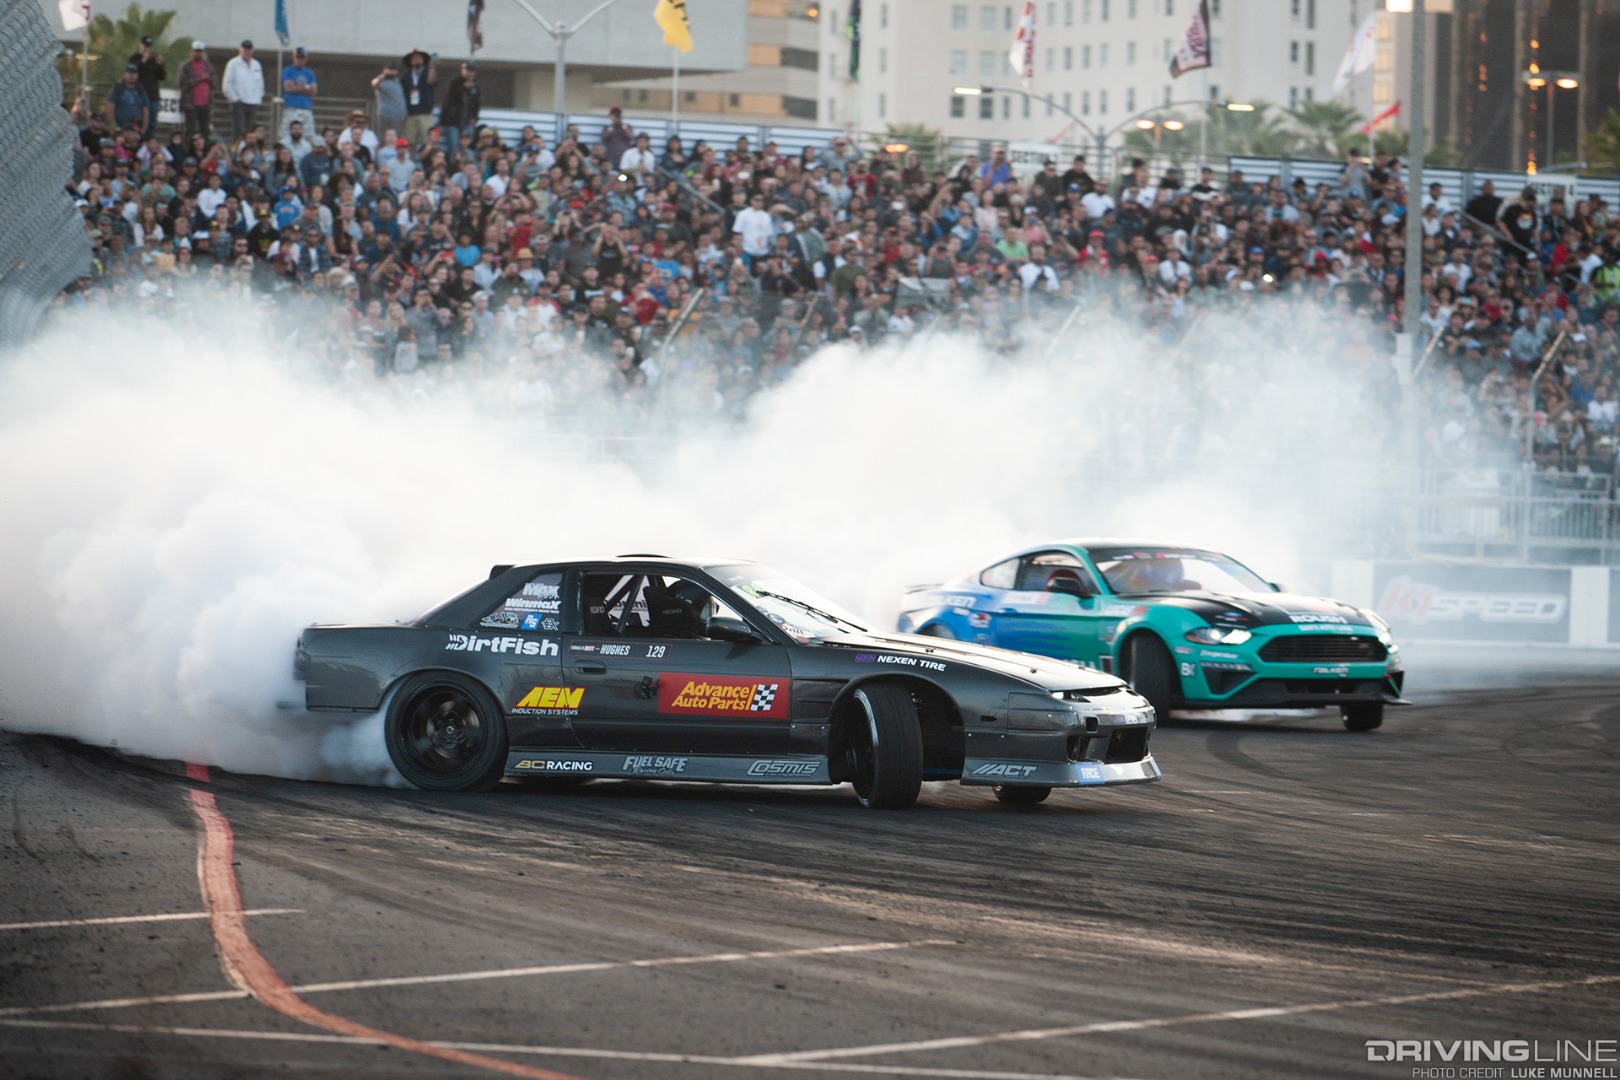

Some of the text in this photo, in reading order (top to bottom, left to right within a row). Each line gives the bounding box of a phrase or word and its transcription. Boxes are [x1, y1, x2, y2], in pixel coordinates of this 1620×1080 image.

[445, 634, 559, 656] DirtFish
[600, 644, 630, 656] HUGHES
[646, 645, 666, 657] 129
[877, 655, 946, 671] NEXEN TIRE
[514, 686, 586, 708] AEM
[680, 681, 750, 699] Advance
[671, 695, 746, 711] Auto Parts
[546, 761, 593, 771] RACING
[622, 756, 688, 772] FUEL SAFE
